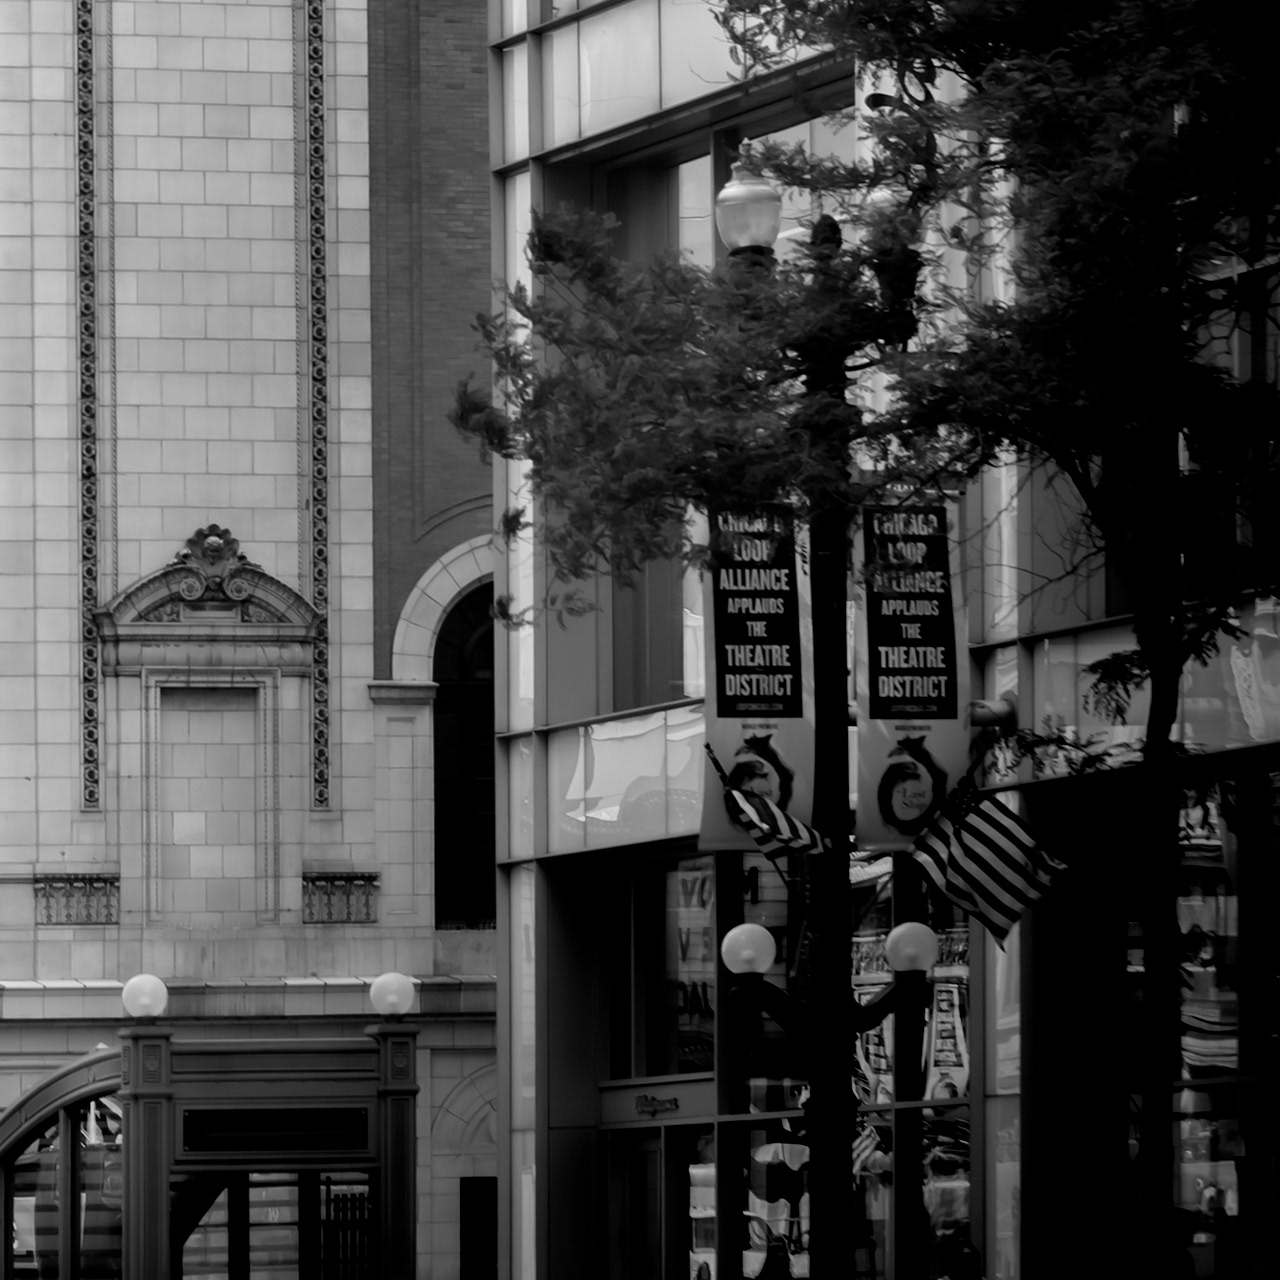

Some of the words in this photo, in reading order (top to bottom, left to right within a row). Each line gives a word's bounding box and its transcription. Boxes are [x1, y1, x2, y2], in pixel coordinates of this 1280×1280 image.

[719, 569, 790, 591] ALLIANCE
[728, 598, 785, 614] APPLAUDS
[881, 599, 939, 616] APPLAUDS
[746, 621, 767, 637] THE
[901, 622, 922, 639] THE
[725, 645, 791, 666] THEATRE
[878, 647, 946, 668] THEATRE
[725, 674, 793, 696] DISTRICT
[878, 676, 948, 698] DISTRICT
